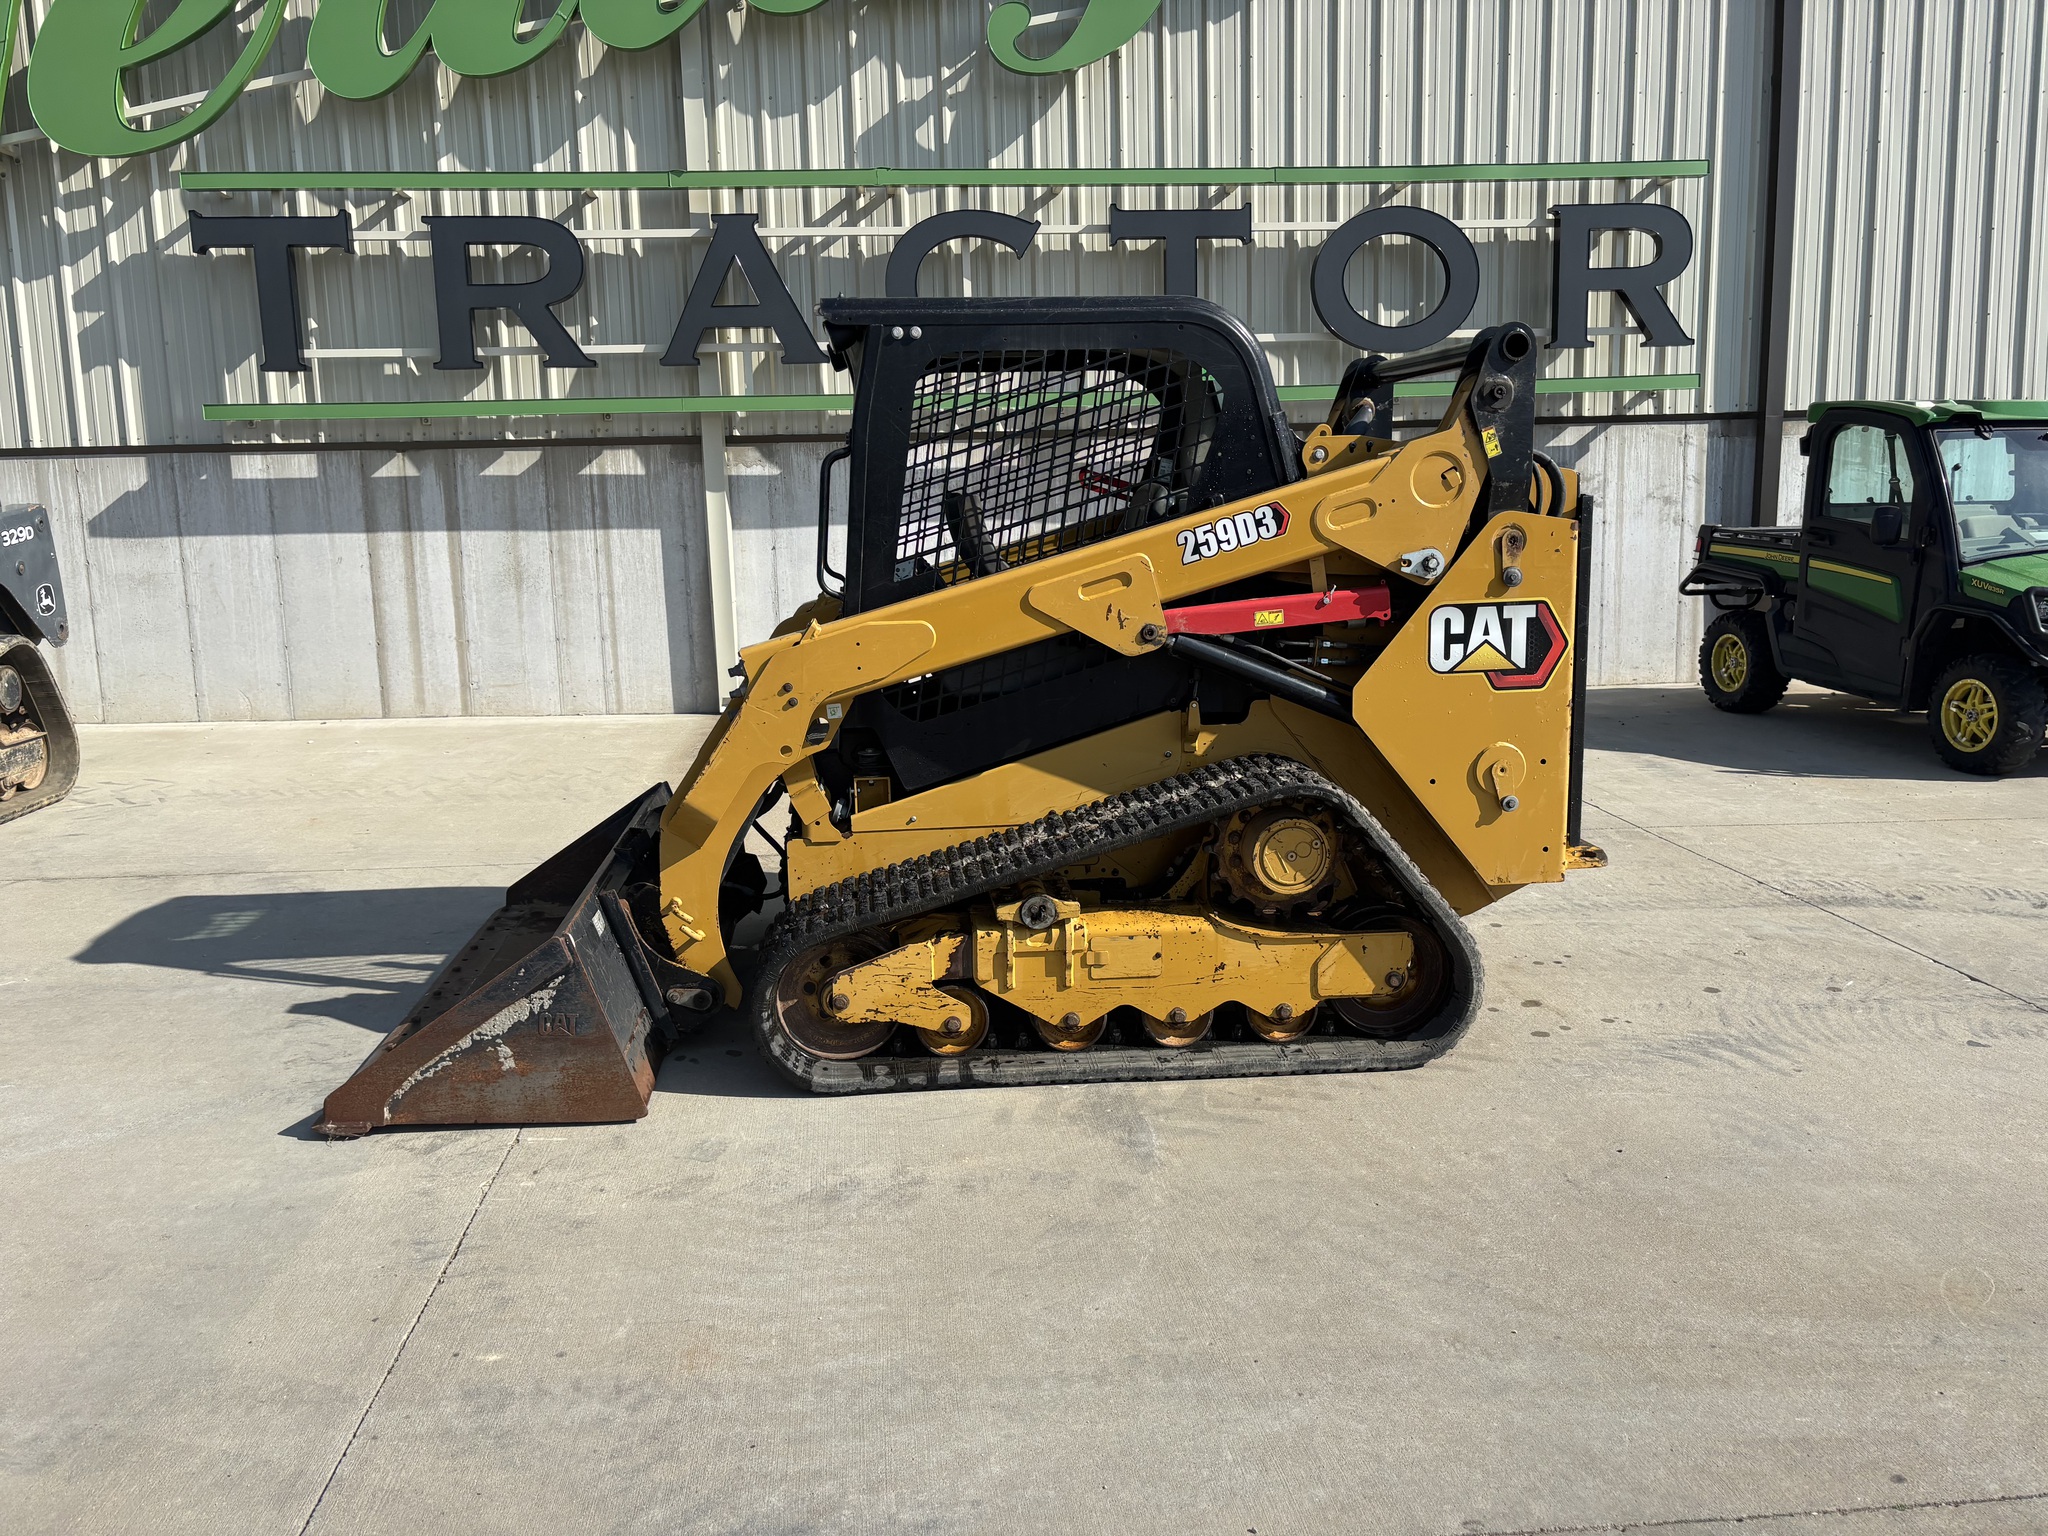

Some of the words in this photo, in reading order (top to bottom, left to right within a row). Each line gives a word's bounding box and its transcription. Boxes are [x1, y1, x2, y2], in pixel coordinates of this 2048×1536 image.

[189, 203, 1695, 372] TRACTOR
[1, 526, 34, 547] 329D
[1177, 505, 1278, 565] 259D3
[1430, 604, 1537, 673] CAT
[539, 1012, 579, 1037] CAT
